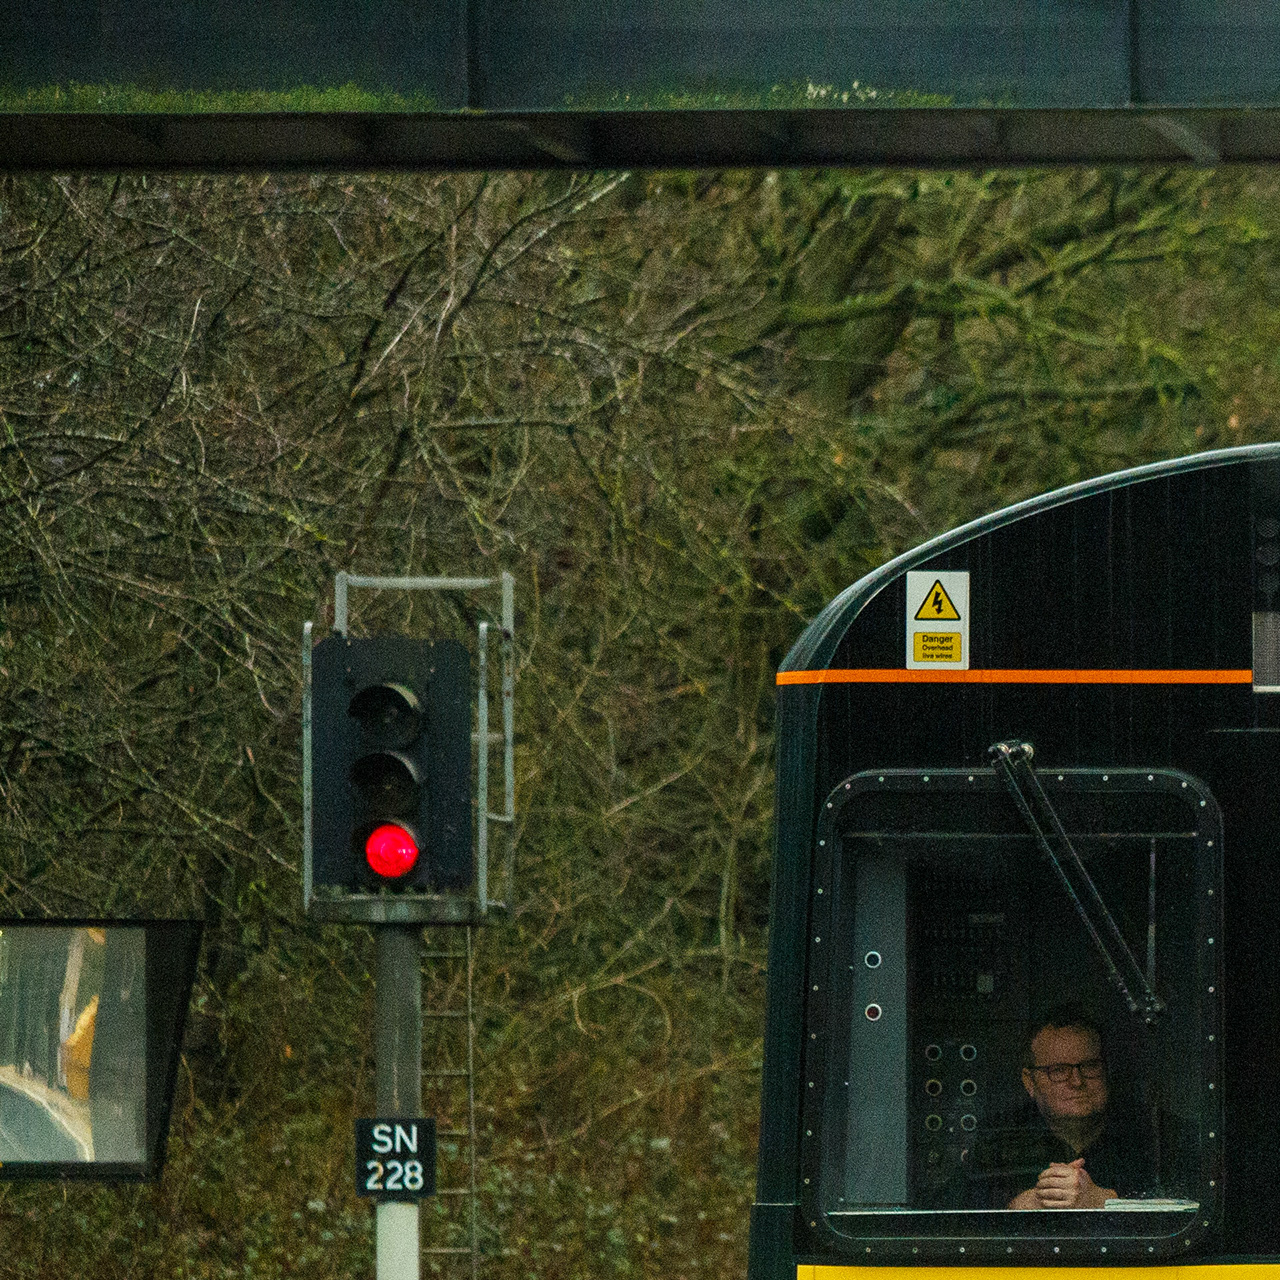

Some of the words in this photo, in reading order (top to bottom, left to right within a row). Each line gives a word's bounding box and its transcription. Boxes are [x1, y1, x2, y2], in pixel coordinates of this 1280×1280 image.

[922, 635, 953, 644] Danger
[371, 1124, 418, 1154] SN
[365, 1160, 424, 1191] 228
